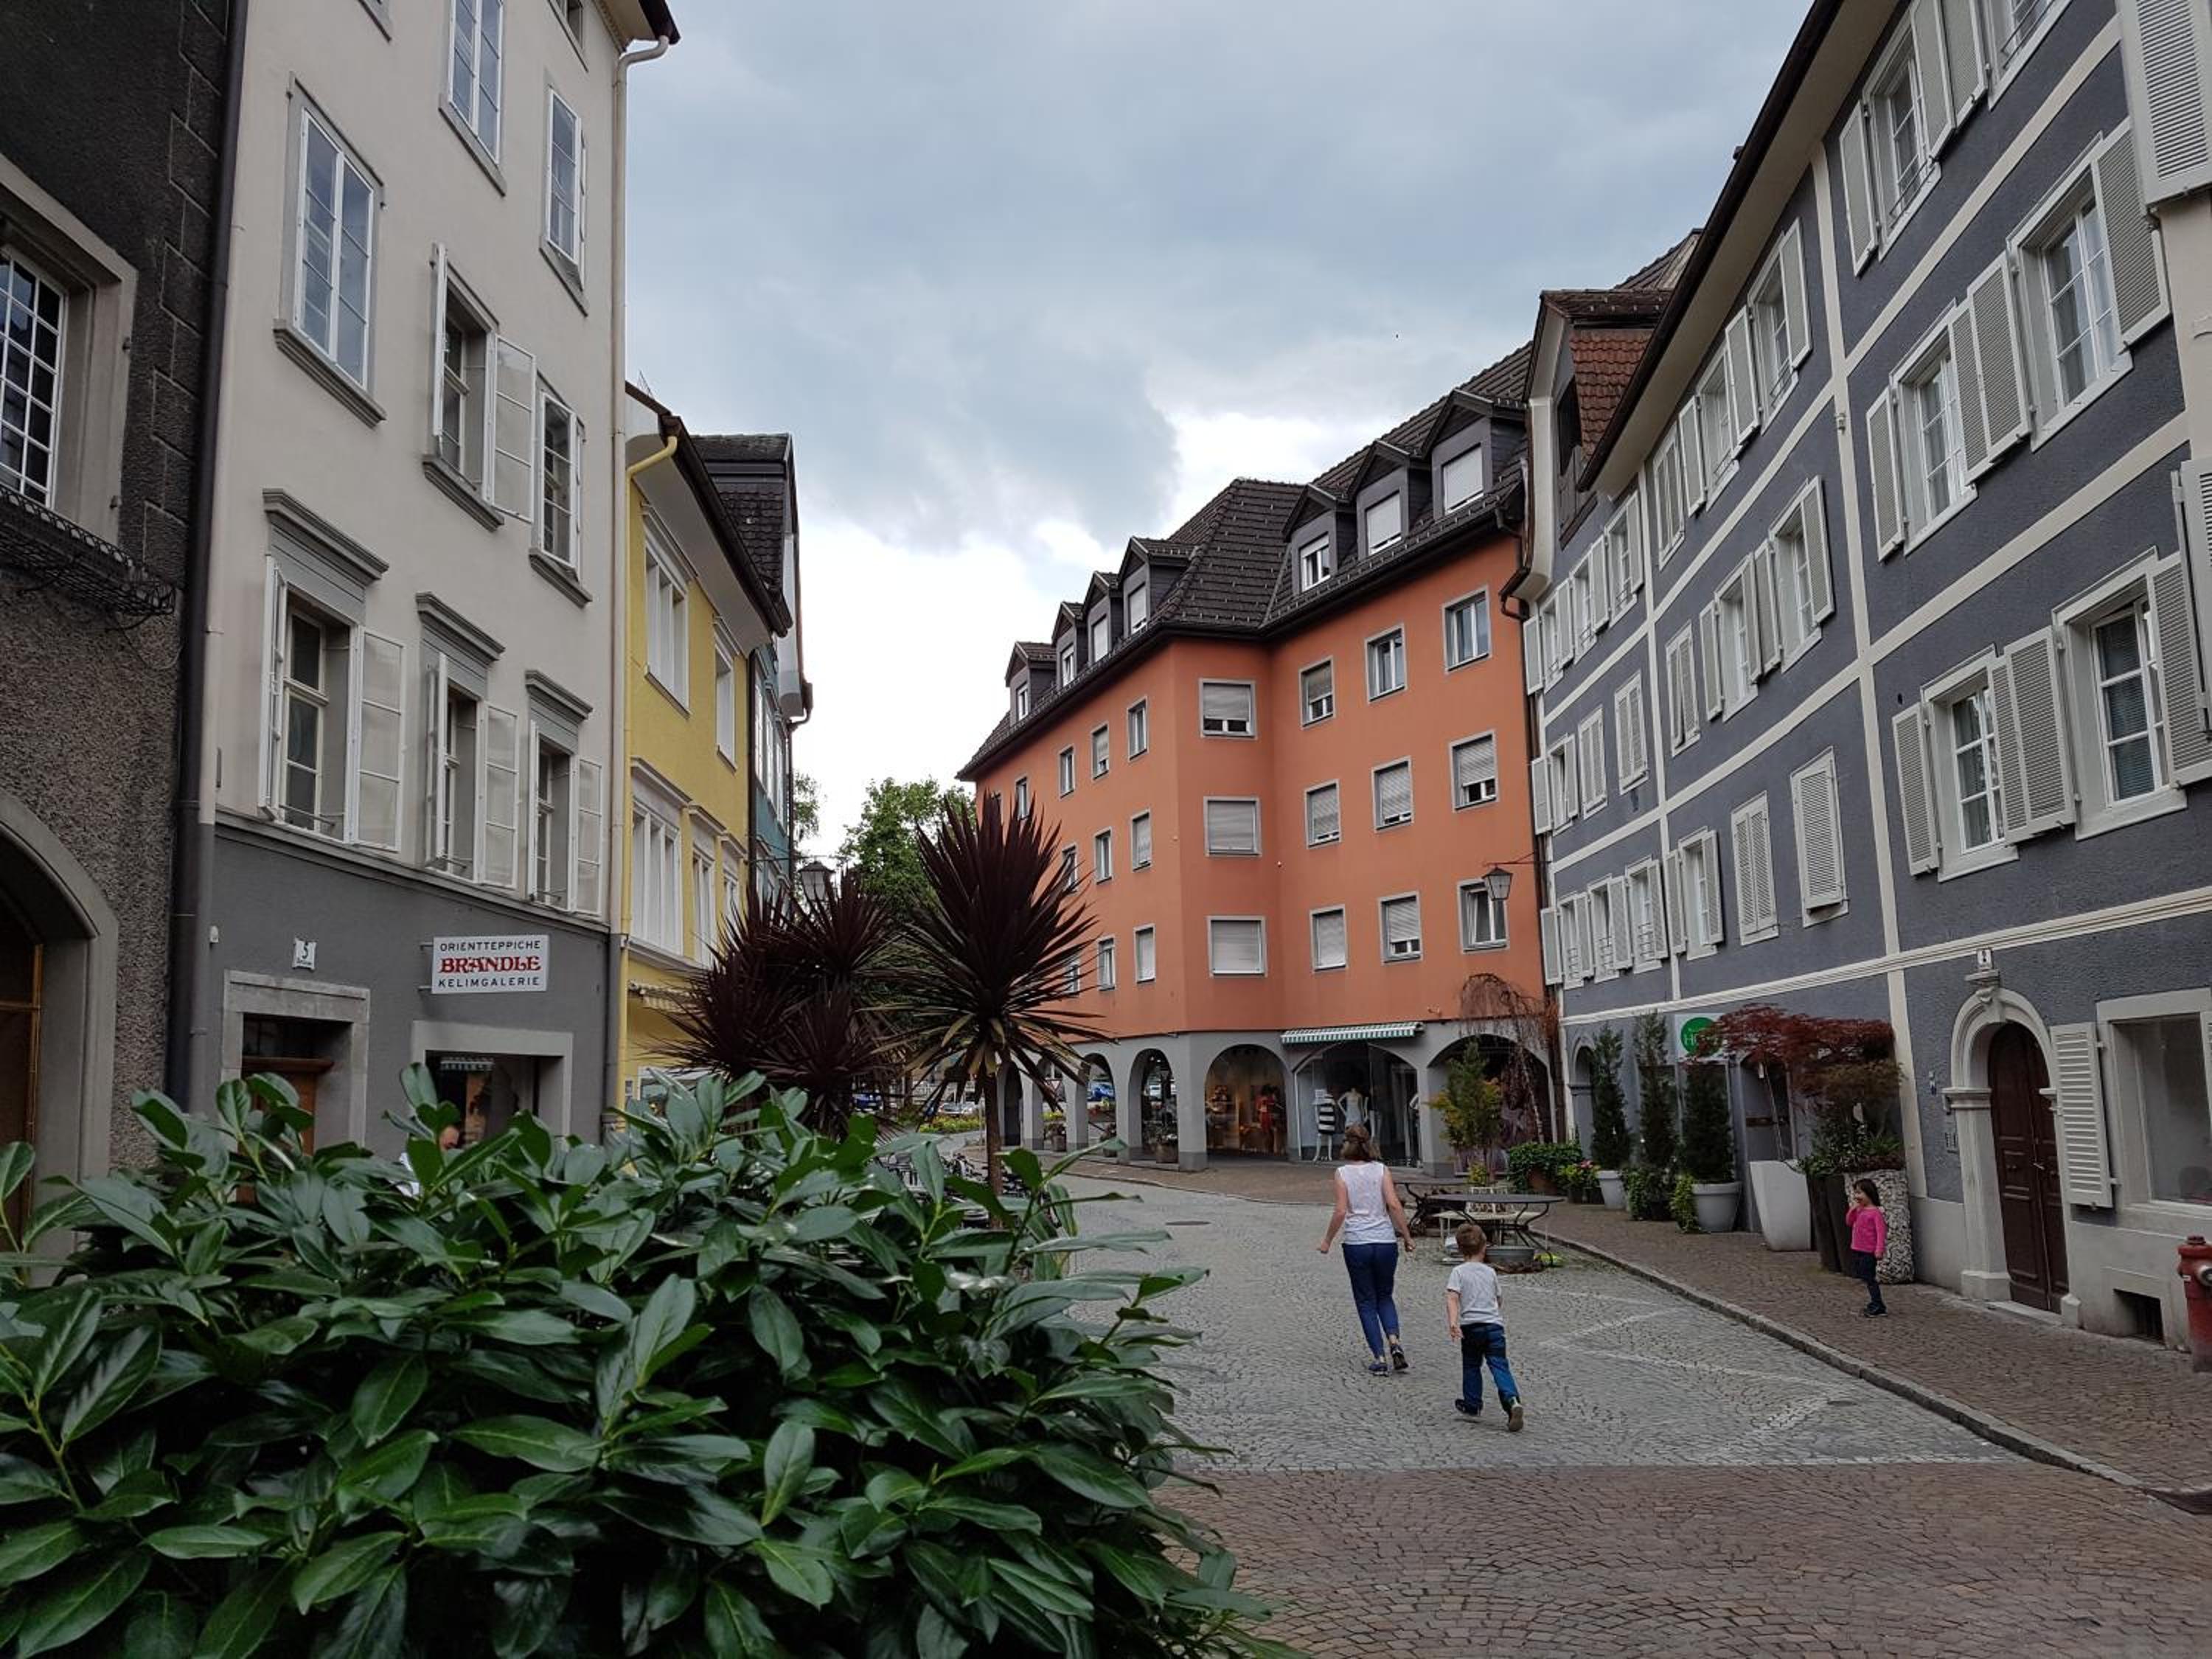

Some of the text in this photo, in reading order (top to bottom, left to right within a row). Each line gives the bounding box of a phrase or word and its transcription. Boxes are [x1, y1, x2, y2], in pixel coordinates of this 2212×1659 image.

[302, 942, 309, 959] 5
[440, 940, 540, 952] ORIENTTEPPICHE
[439, 977, 540, 987] KELIMGALERIE
